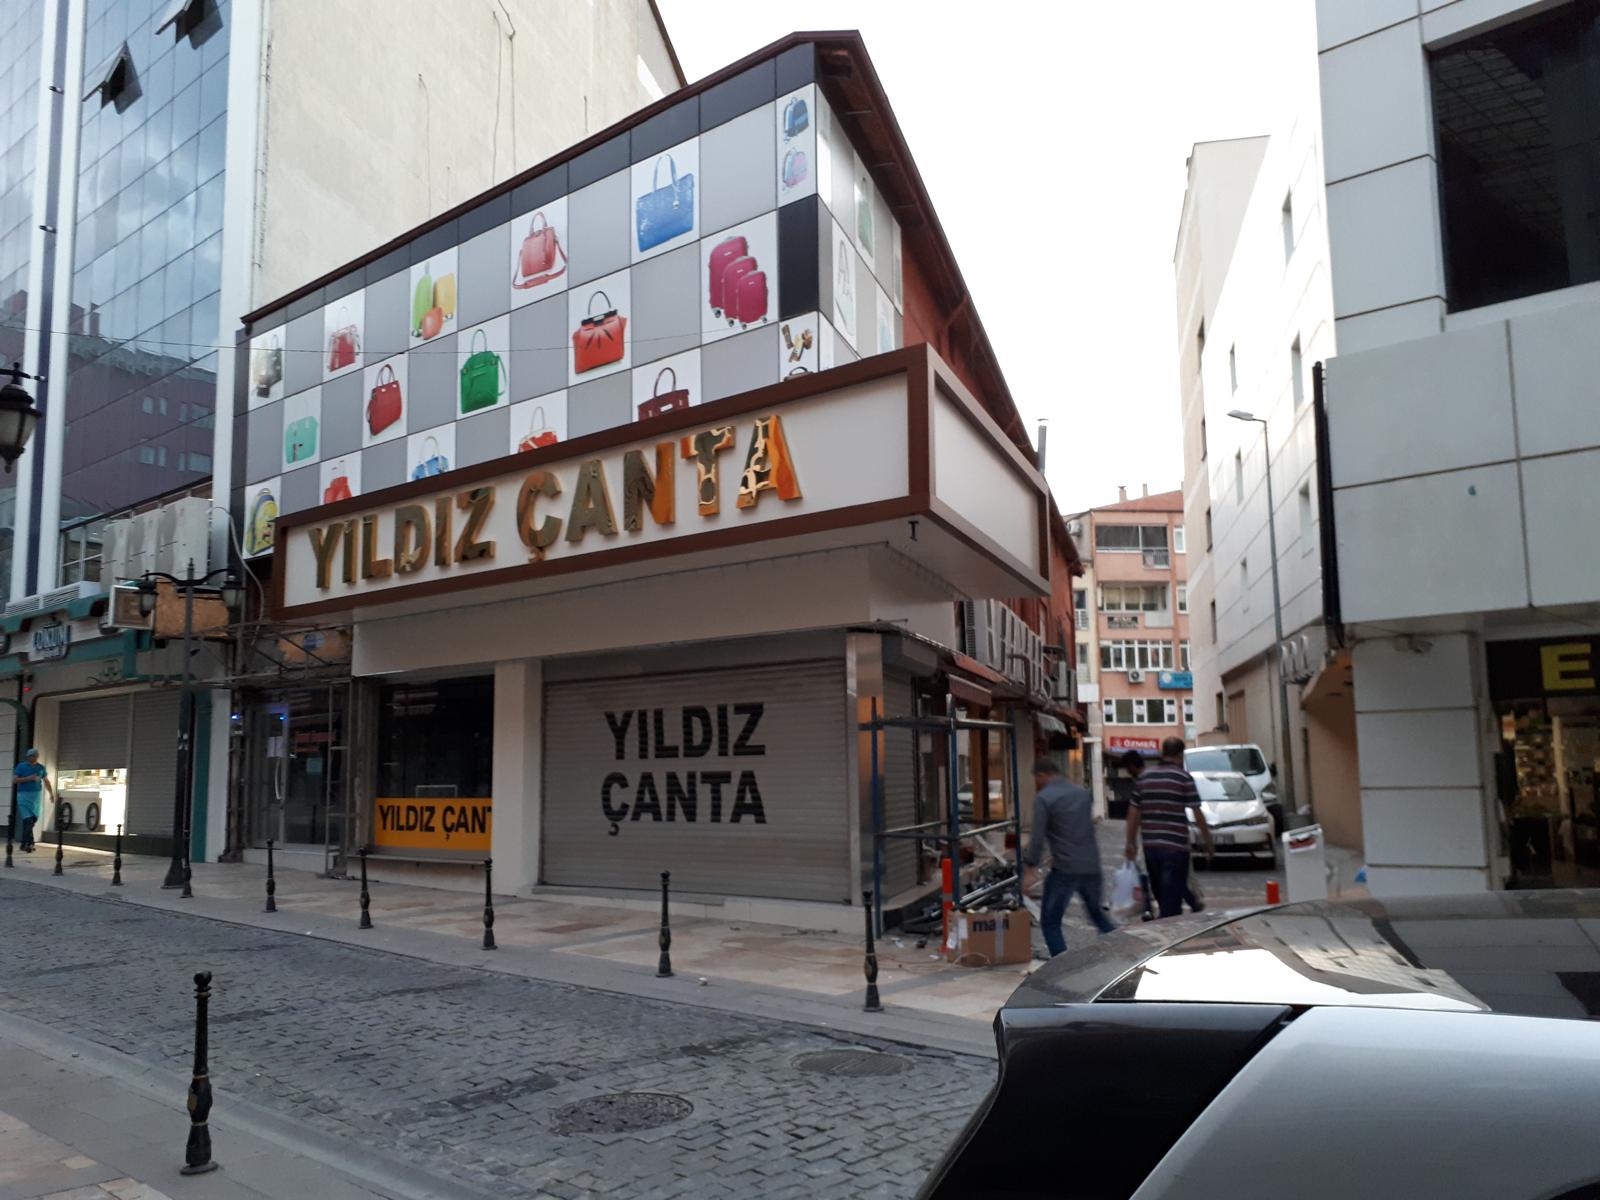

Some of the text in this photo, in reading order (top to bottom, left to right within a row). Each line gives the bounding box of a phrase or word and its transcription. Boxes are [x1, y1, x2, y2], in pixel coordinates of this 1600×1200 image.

[308, 415, 803, 589] YILDIZ ÇANTA
[1540, 643, 1595, 690] E
[604, 702, 766, 760] YILDIZ
[378, 804, 436, 832] YILDIZ
[601, 770, 767, 836] ÇANTA
[972, 914, 1010, 932] mai
